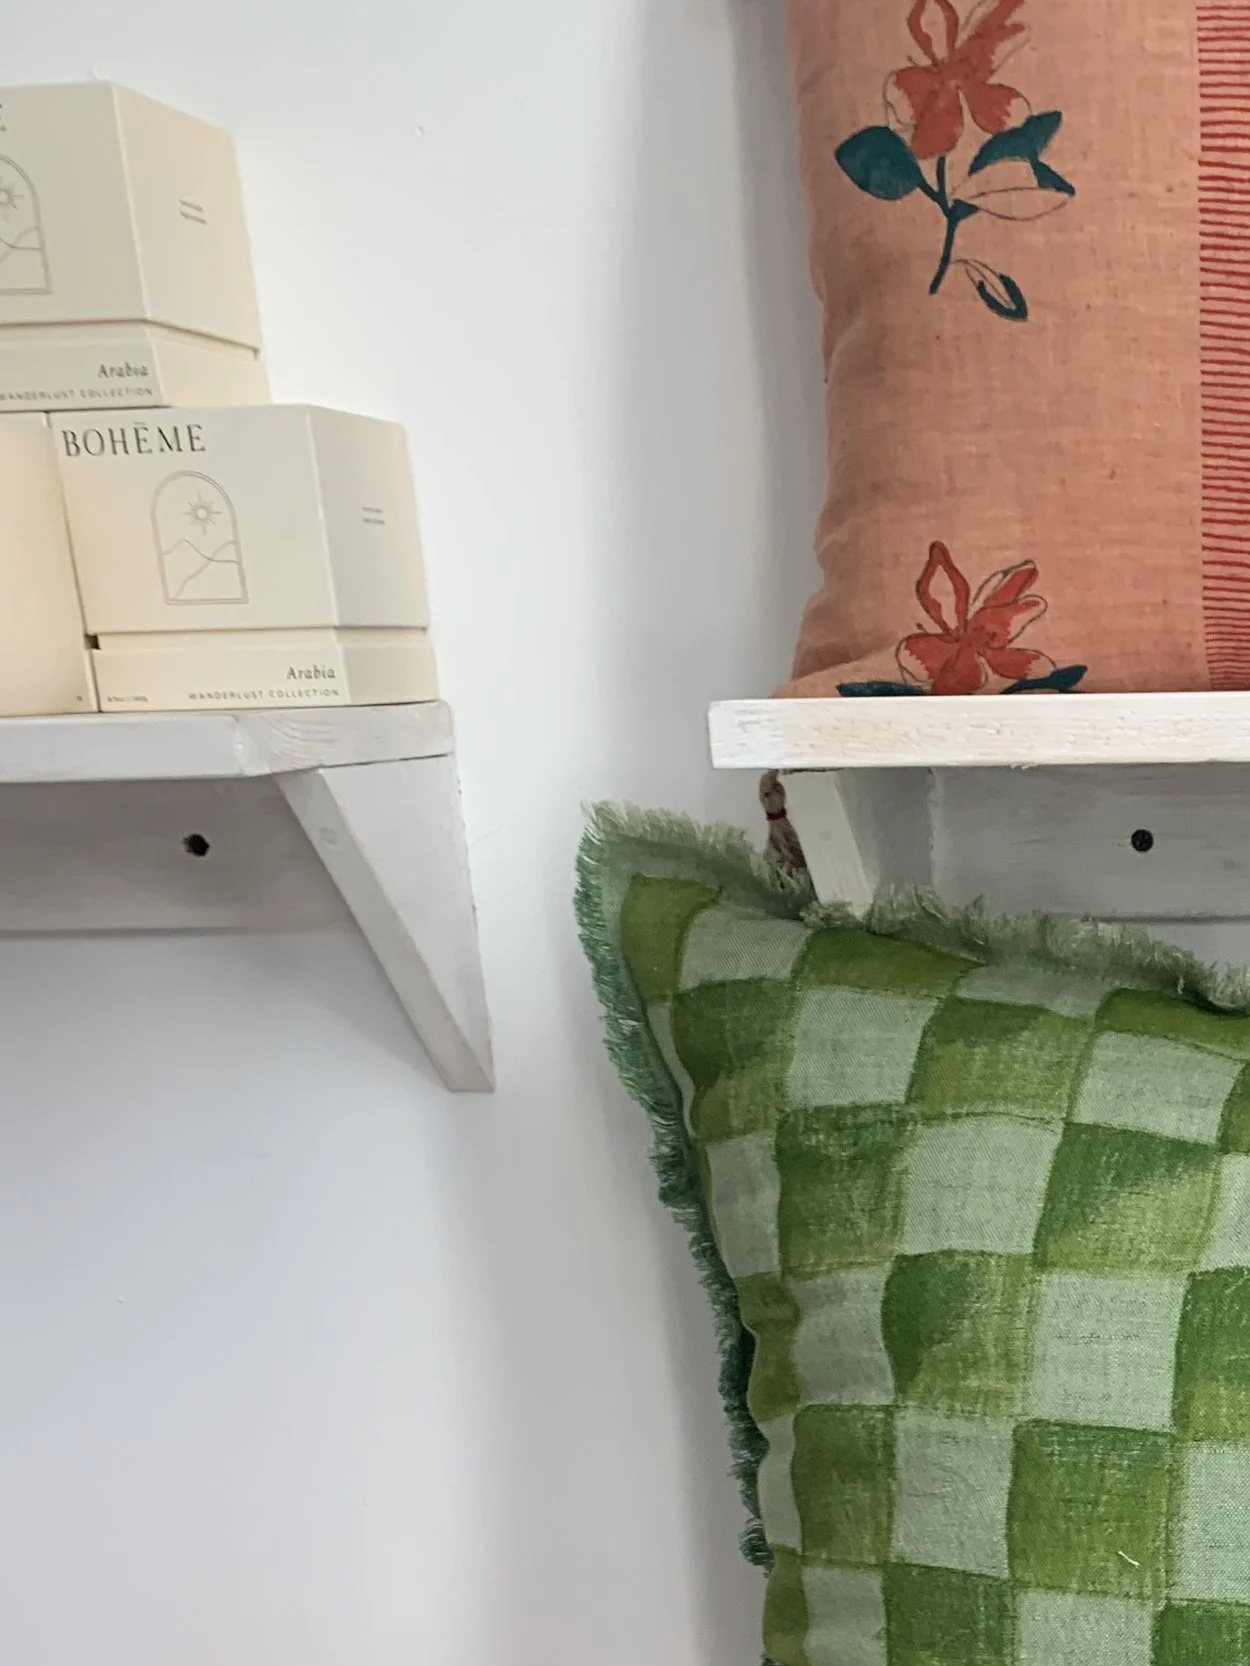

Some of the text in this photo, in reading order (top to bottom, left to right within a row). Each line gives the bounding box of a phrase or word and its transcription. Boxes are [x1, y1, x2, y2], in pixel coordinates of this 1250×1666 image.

[98, 361, 149, 378] Arabia
[79, 386, 153, 398] COLLECTION
[61, 421, 206, 457] BOHĒME
[286, 664, 336, 680] Arabia
[187, 688, 341, 700] WANDERLUST COLLECTION
